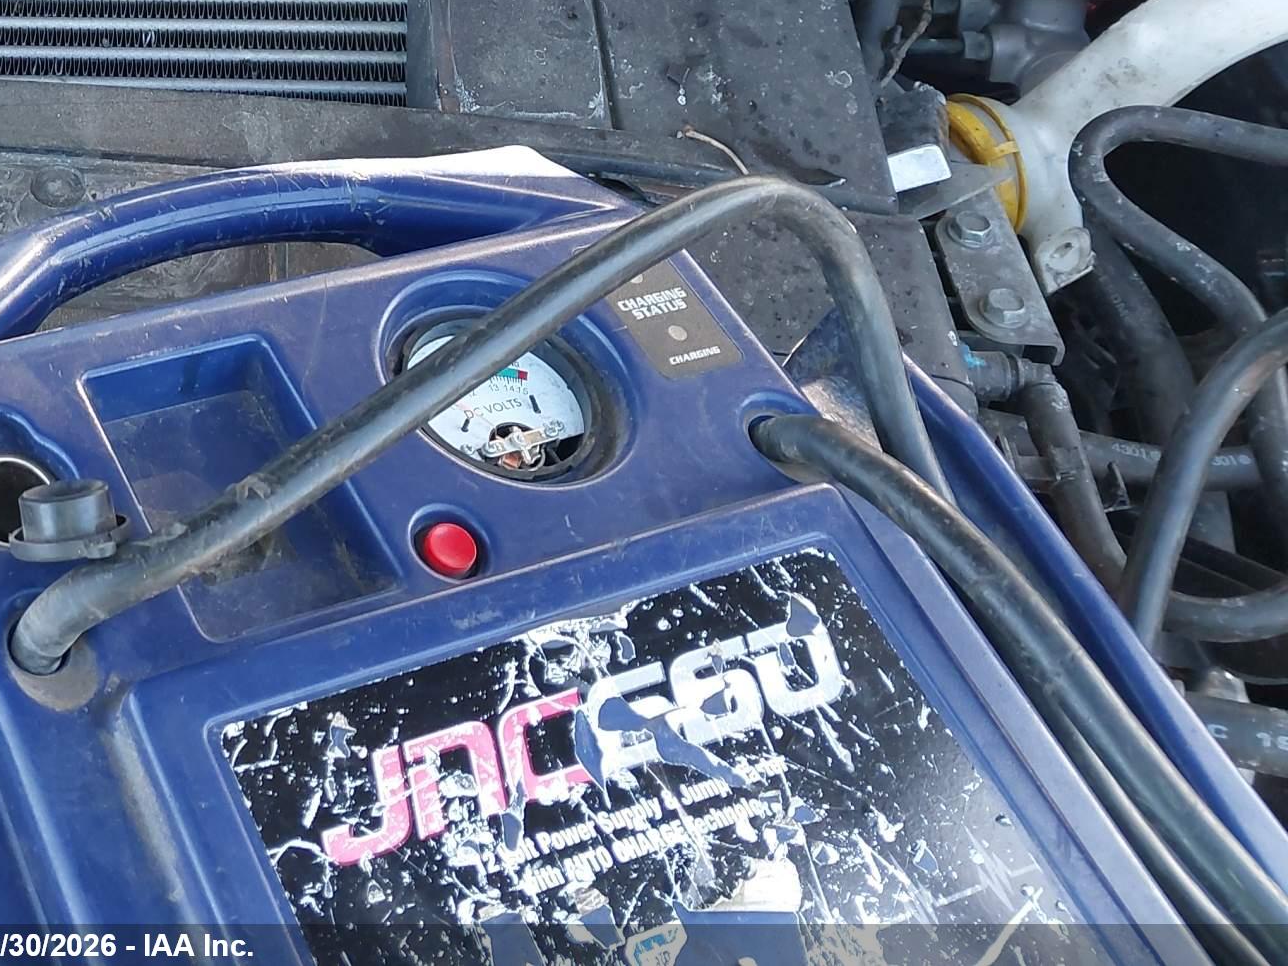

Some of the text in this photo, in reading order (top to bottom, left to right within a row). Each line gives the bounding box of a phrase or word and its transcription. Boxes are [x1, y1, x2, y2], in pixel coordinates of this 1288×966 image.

[617, 287, 688, 312] CHARGING
[632, 299, 688, 320] STATUS
[669, 346, 721, 365] CHARGING
[489, 383, 500, 392] 13
[504, 384, 515, 393] 14
[464, 397, 523, 420] DC VOLTS
[536, 817, 597, 853] Power
[594, 797, 663, 835] Supply
[660, 789, 680, 811] &
[681, 777, 734, 807] Jump
[562, 845, 614, 883] AUTO
[611, 820, 689, 865] CHARGE
